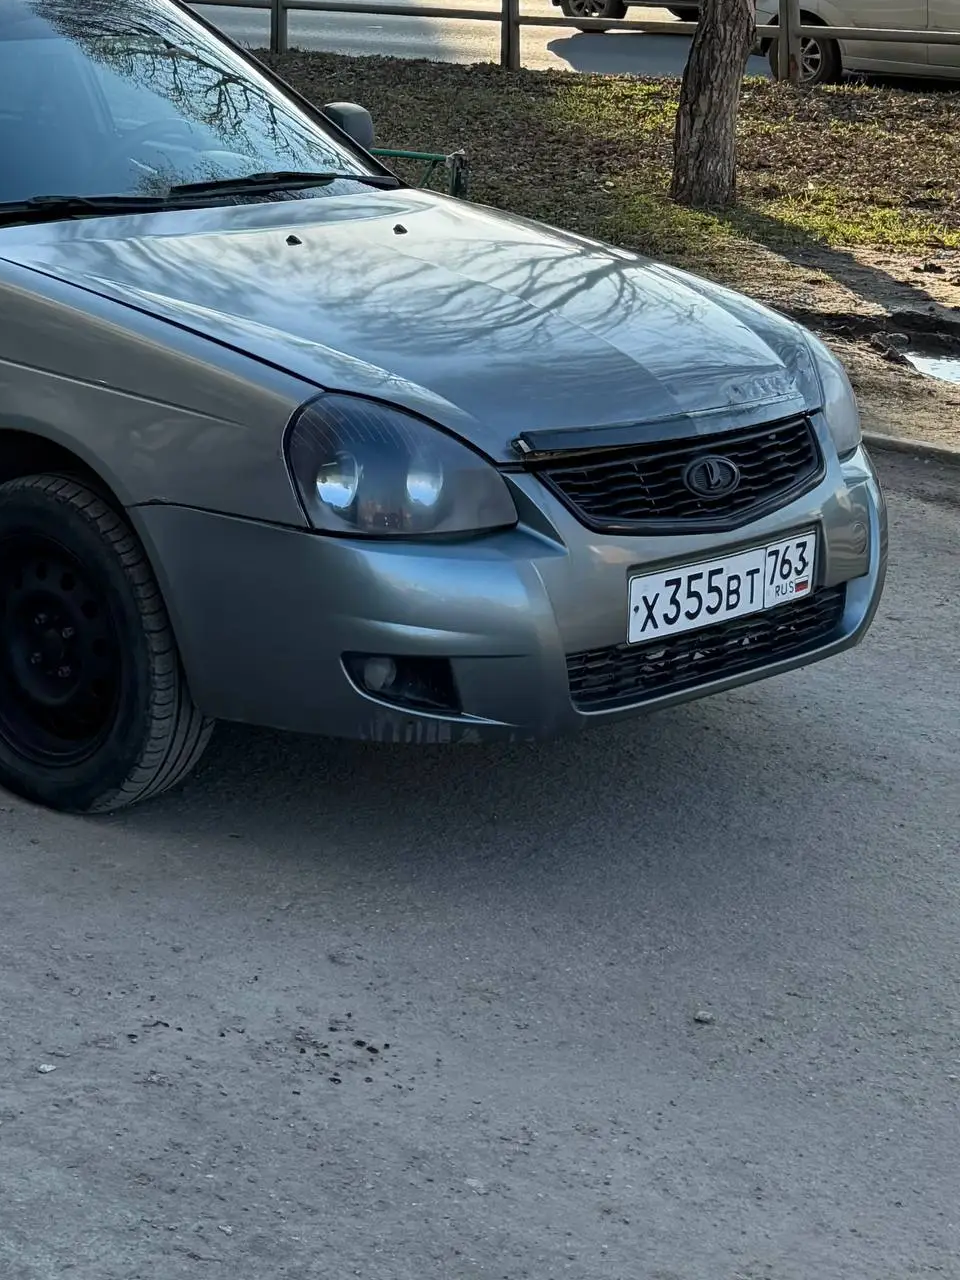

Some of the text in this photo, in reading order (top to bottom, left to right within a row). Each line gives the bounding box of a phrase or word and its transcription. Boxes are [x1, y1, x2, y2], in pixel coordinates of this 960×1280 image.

[640, 541, 808, 632] Х355ВТ 763
[775, 581, 794, 597] RUS
